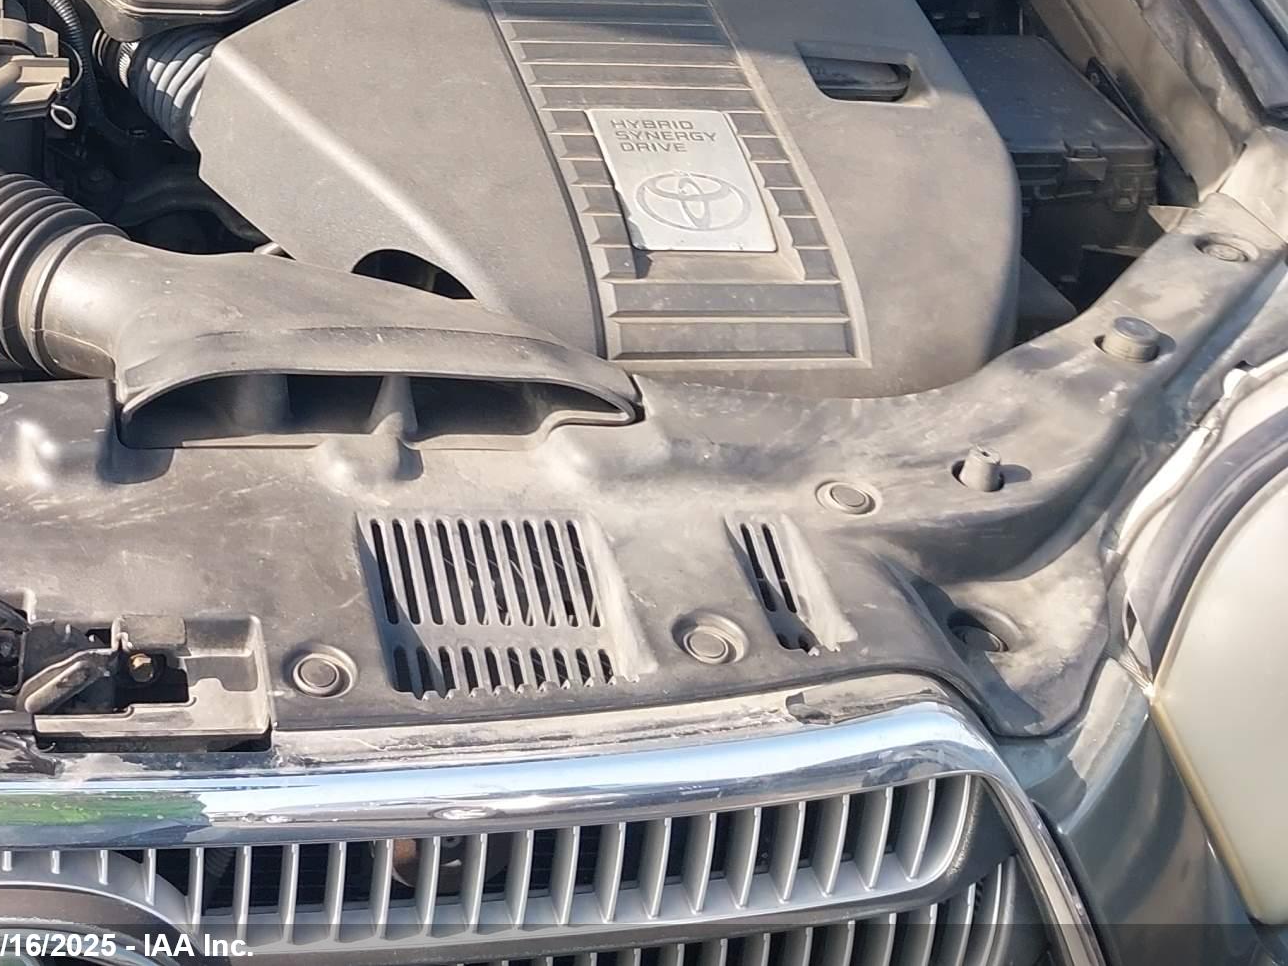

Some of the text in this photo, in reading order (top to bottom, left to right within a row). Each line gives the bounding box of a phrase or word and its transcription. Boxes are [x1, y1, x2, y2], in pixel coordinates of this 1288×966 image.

[610, 119, 694, 130] HYBRID
[615, 130, 717, 142] SYNERGY
[620, 142, 688, 153] DRIVE
